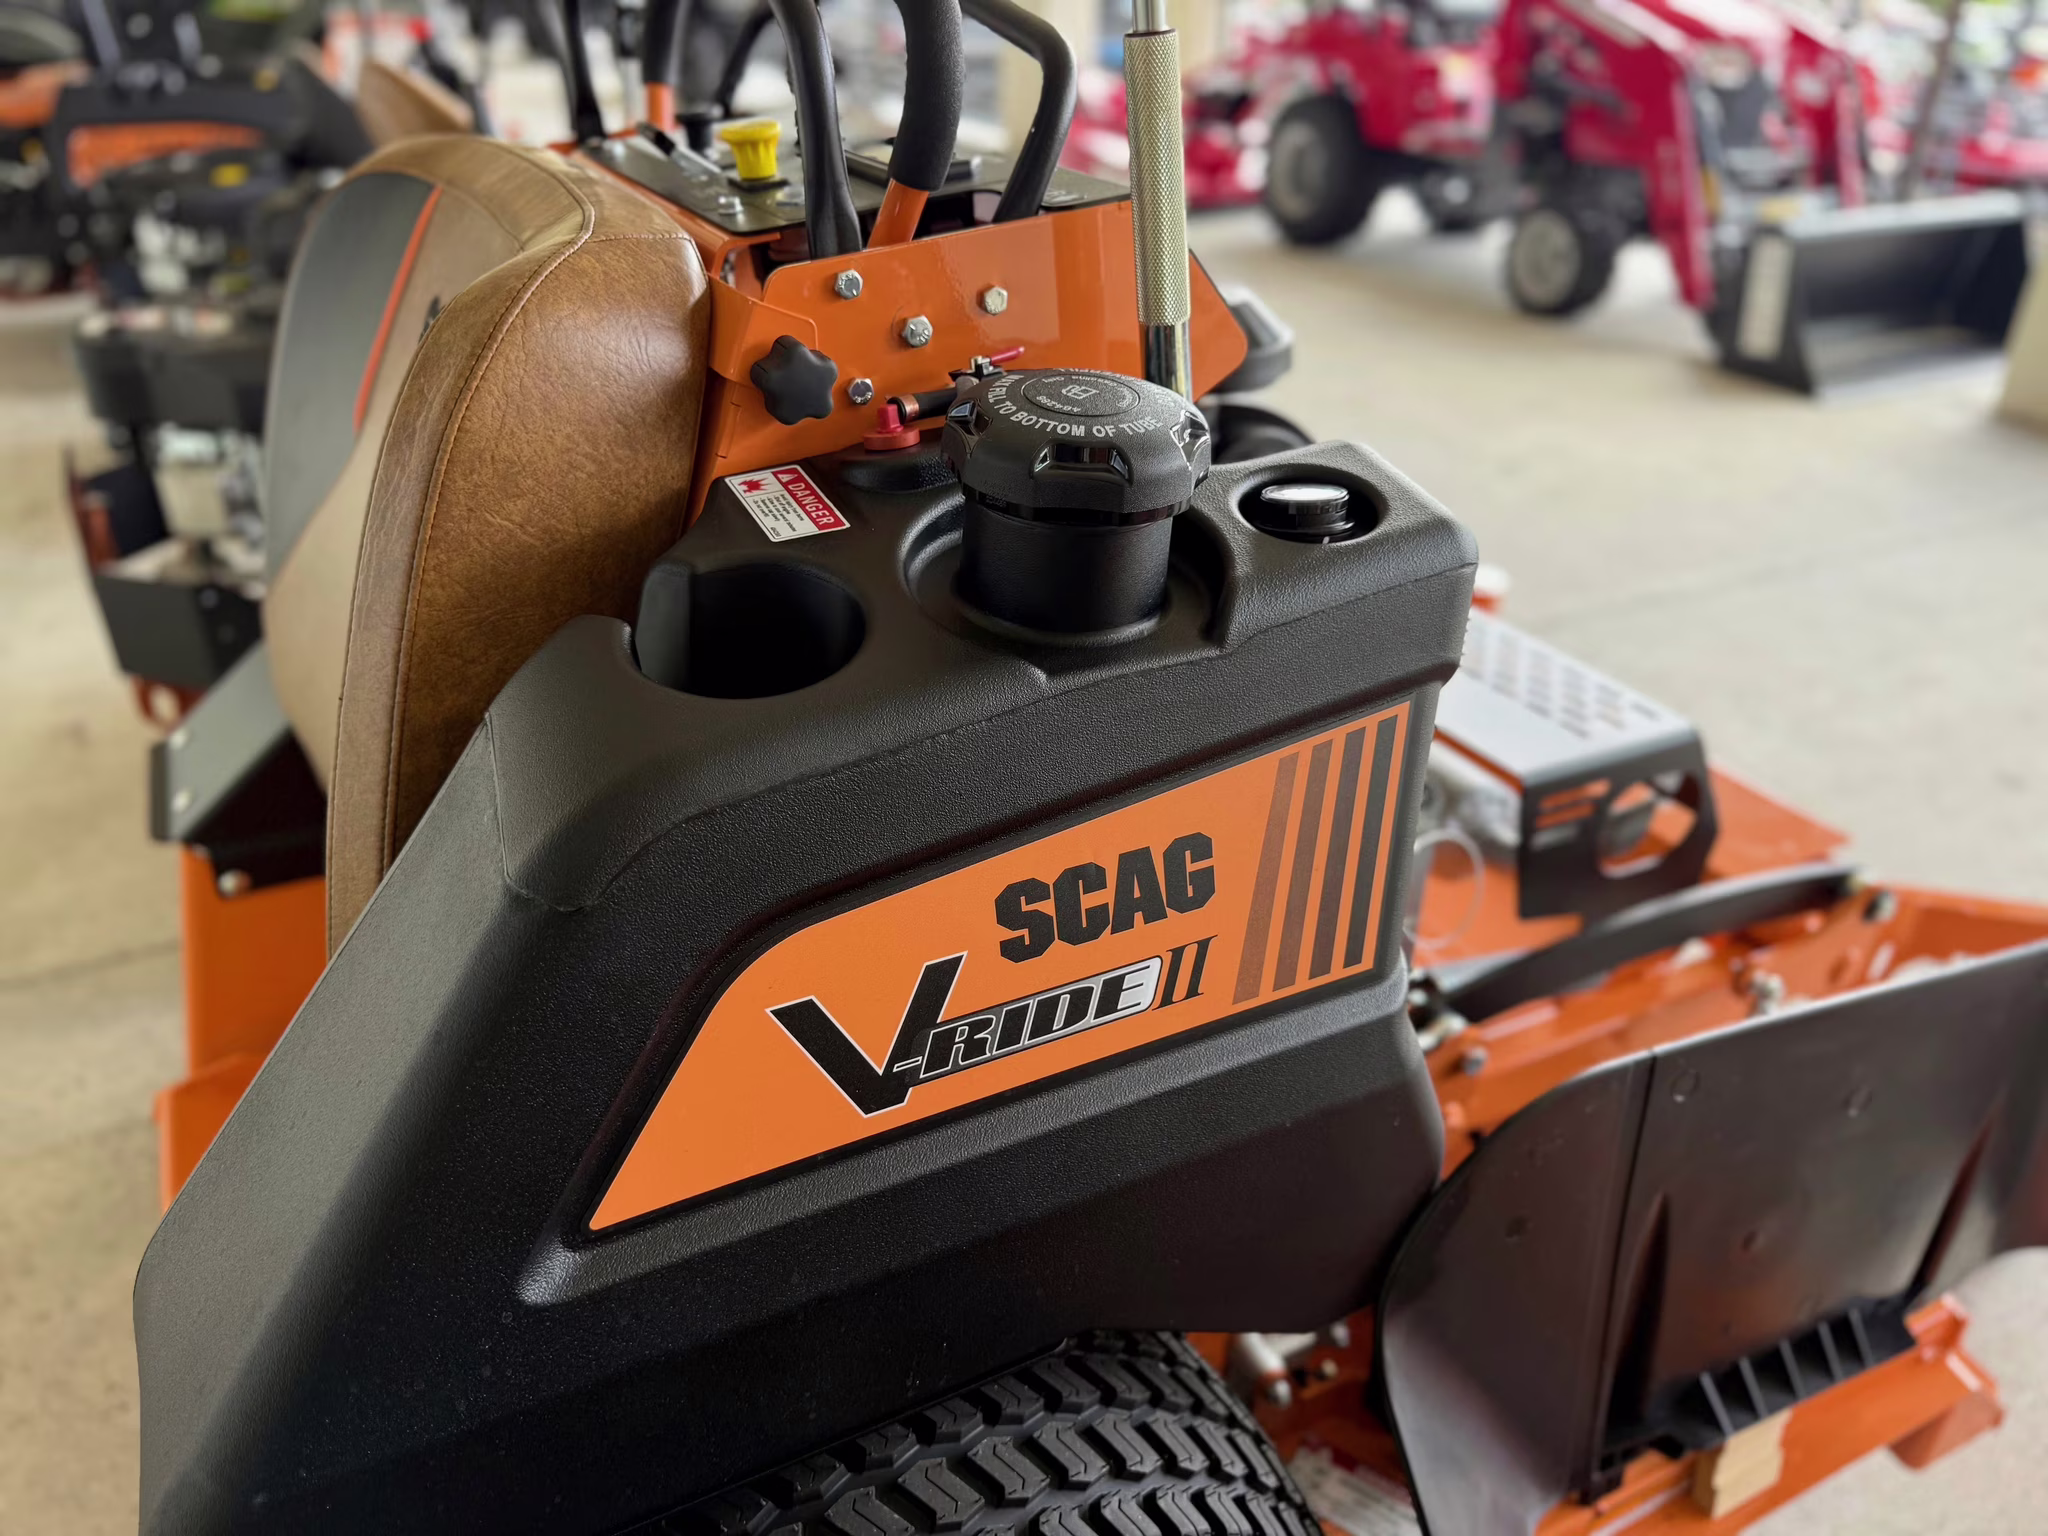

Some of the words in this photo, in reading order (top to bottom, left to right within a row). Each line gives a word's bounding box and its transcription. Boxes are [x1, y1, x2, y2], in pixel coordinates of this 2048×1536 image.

[988, 387, 1007, 403] FILL
[994, 401, 1017, 414] TO
[1010, 411, 1085, 437] BOTTOM
[1092, 425, 1117, 437] OF
[1118, 416, 1163, 435] TUBE
[787, 482, 835, 525] DANGER
[995, 832, 1215, 963] SCAG
[1152, 935, 1218, 1011] II
